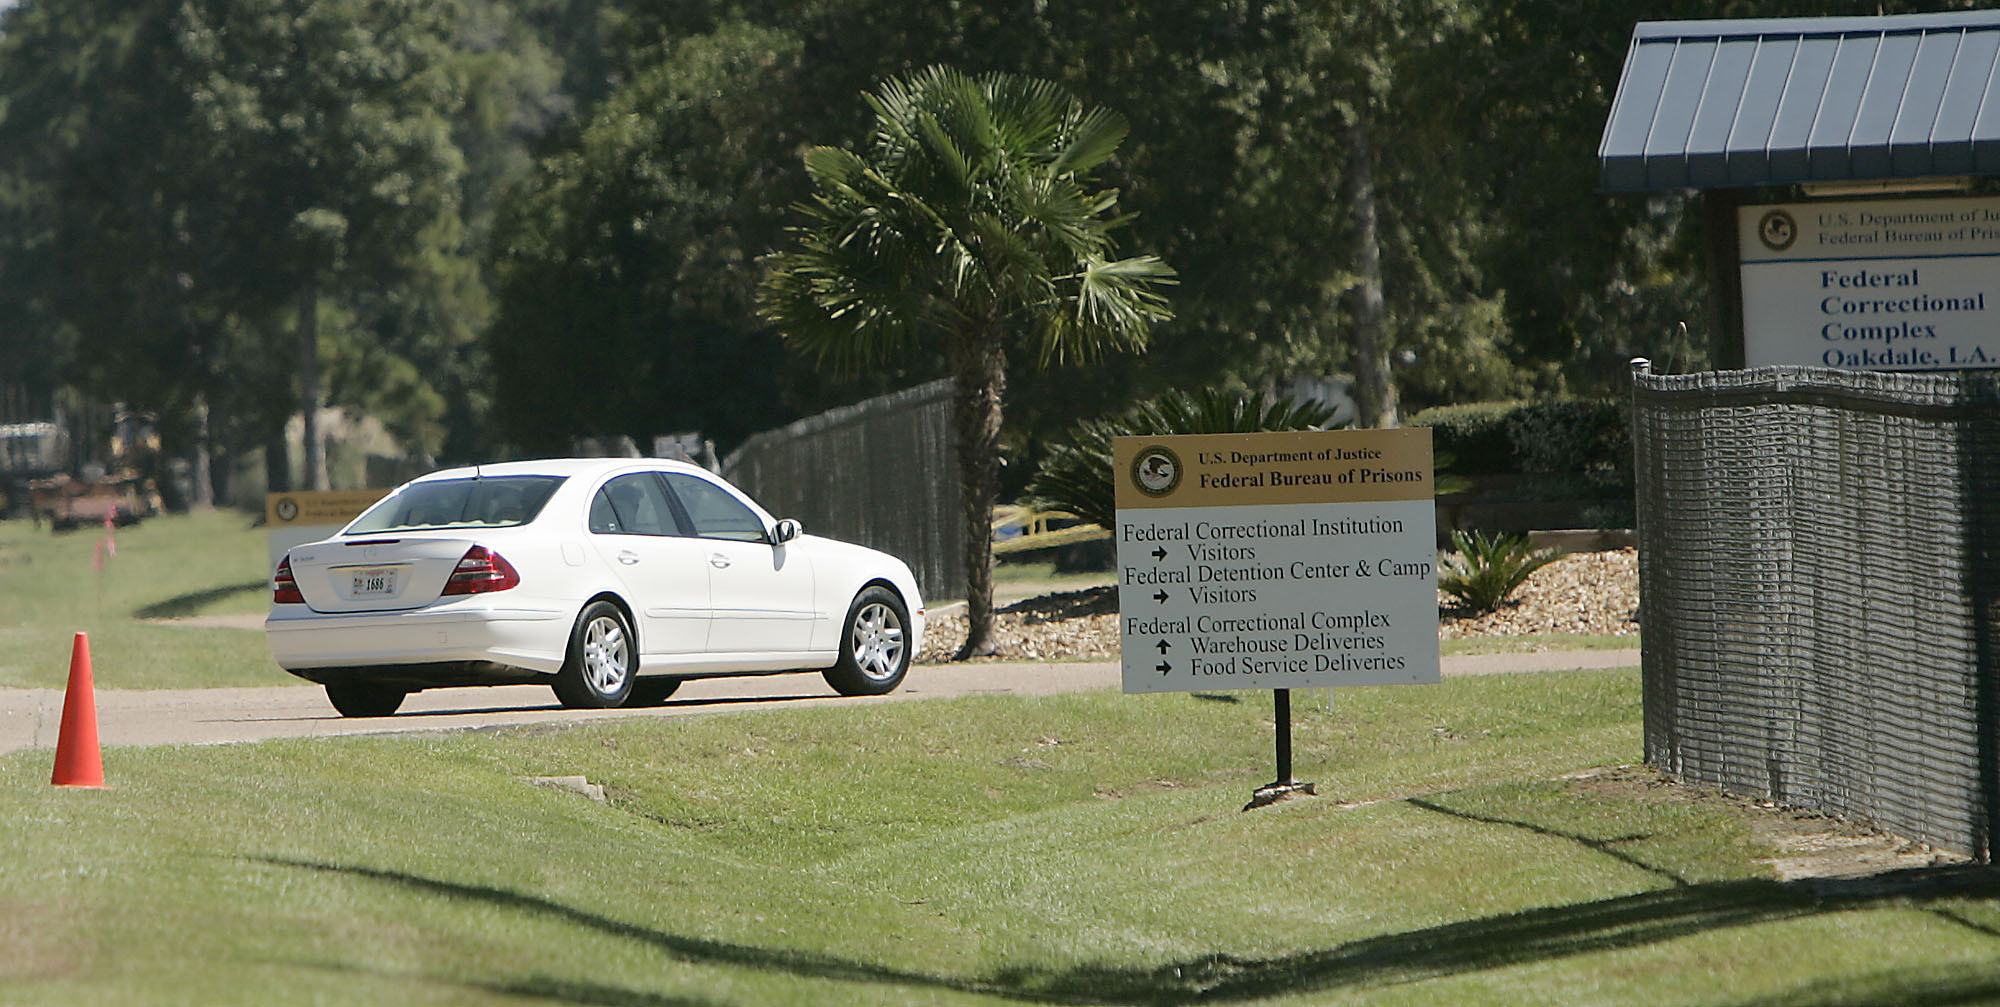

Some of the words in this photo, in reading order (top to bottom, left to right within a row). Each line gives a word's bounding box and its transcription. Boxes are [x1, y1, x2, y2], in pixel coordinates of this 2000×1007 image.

[1818, 212, 1854, 227] U.S.
[1859, 208, 1955, 227] Department
[1960, 208, 1977, 221] of
[1818, 230, 1879, 245] Federal
[1884, 228, 1943, 242] Bureau
[1948, 227, 1965, 240] of
[1821, 268, 1919, 288] Federal
[1820, 292, 1985, 315] Correctional
[1821, 321, 1936, 344] Complex
[1822, 346, 1940, 367] Oakdale,
[1199, 452, 1226, 465] U.S.
[1231, 449, 1313, 466] Department
[1317, 449, 1331, 461] of
[1334, 448, 1382, 461] Justice
[1200, 472, 1264, 488] Federal
[1270, 470, 1332, 487] Bureau
[1338, 468, 1355, 484] of
[1360, 468, 1423, 484] Prisons
[1123, 522, 1189, 542] Federal
[1196, 519, 1306, 540] Correctional
[1312, 515, 1403, 536] Institution
[1187, 543, 1256, 562] Visitors
[1124, 565, 1192, 585] Federal
[1198, 562, 1284, 583] Detention
[1290, 561, 1349, 580] Center
[1355, 560, 1372, 578] &
[1378, 558, 1431, 580] Camp
[1189, 585, 1257, 605] Visitors
[1127, 616, 1191, 636] Federal
[1197, 612, 1305, 633] Correctional
[1311, 610, 1391, 632] Complex
[1191, 635, 1288, 654] Warehouse
[1294, 632, 1385, 651] Deliveries
[1191, 656, 1236, 676] Food
[1242, 654, 1309, 674] Service
[1314, 652, 1405, 672] Deliveries
